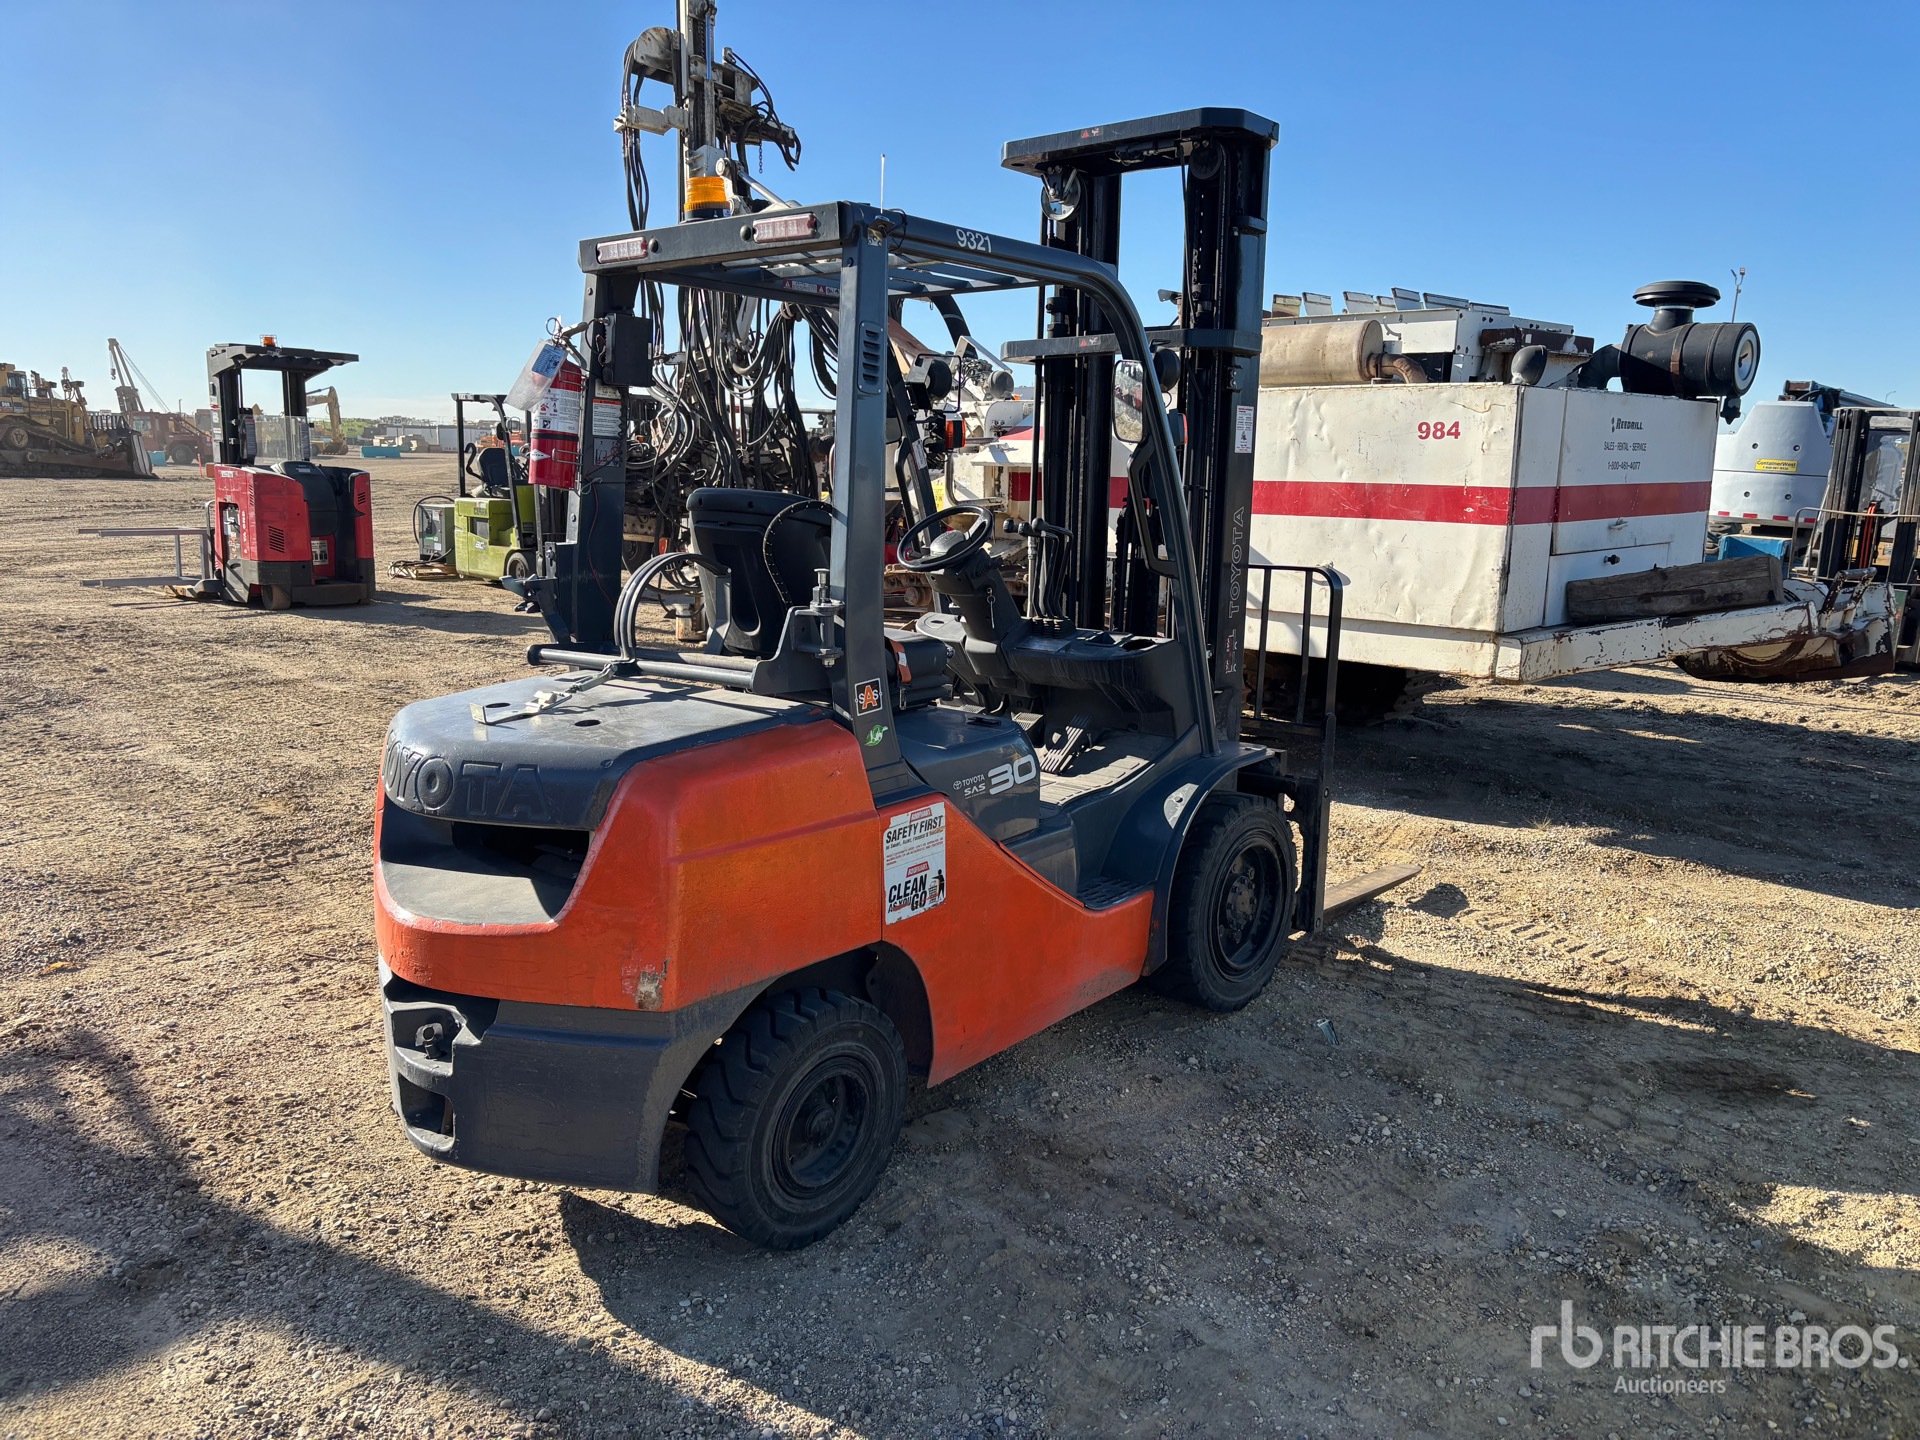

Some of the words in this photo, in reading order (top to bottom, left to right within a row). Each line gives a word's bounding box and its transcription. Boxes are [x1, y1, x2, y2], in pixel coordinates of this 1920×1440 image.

[956, 229, 991, 253] 9321
[1418, 421, 1461, 440] 984
[1604, 442, 1615, 451] SALES
[1617, 442, 1629, 451] RENTAL
[1632, 442, 1647, 451] SERVICE
[1229, 506, 1245, 619] TOYOTA
[858, 684, 879, 710] SAS
[962, 774, 985, 787] TOYOTA
[987, 754, 1037, 795] 30
[964, 783, 986, 796] SAS
[886, 822, 919, 843] SAFETY
[919, 815, 944, 833] FIRST
[888, 873, 927, 904] CLEAN
[911, 890, 928, 912] GO
